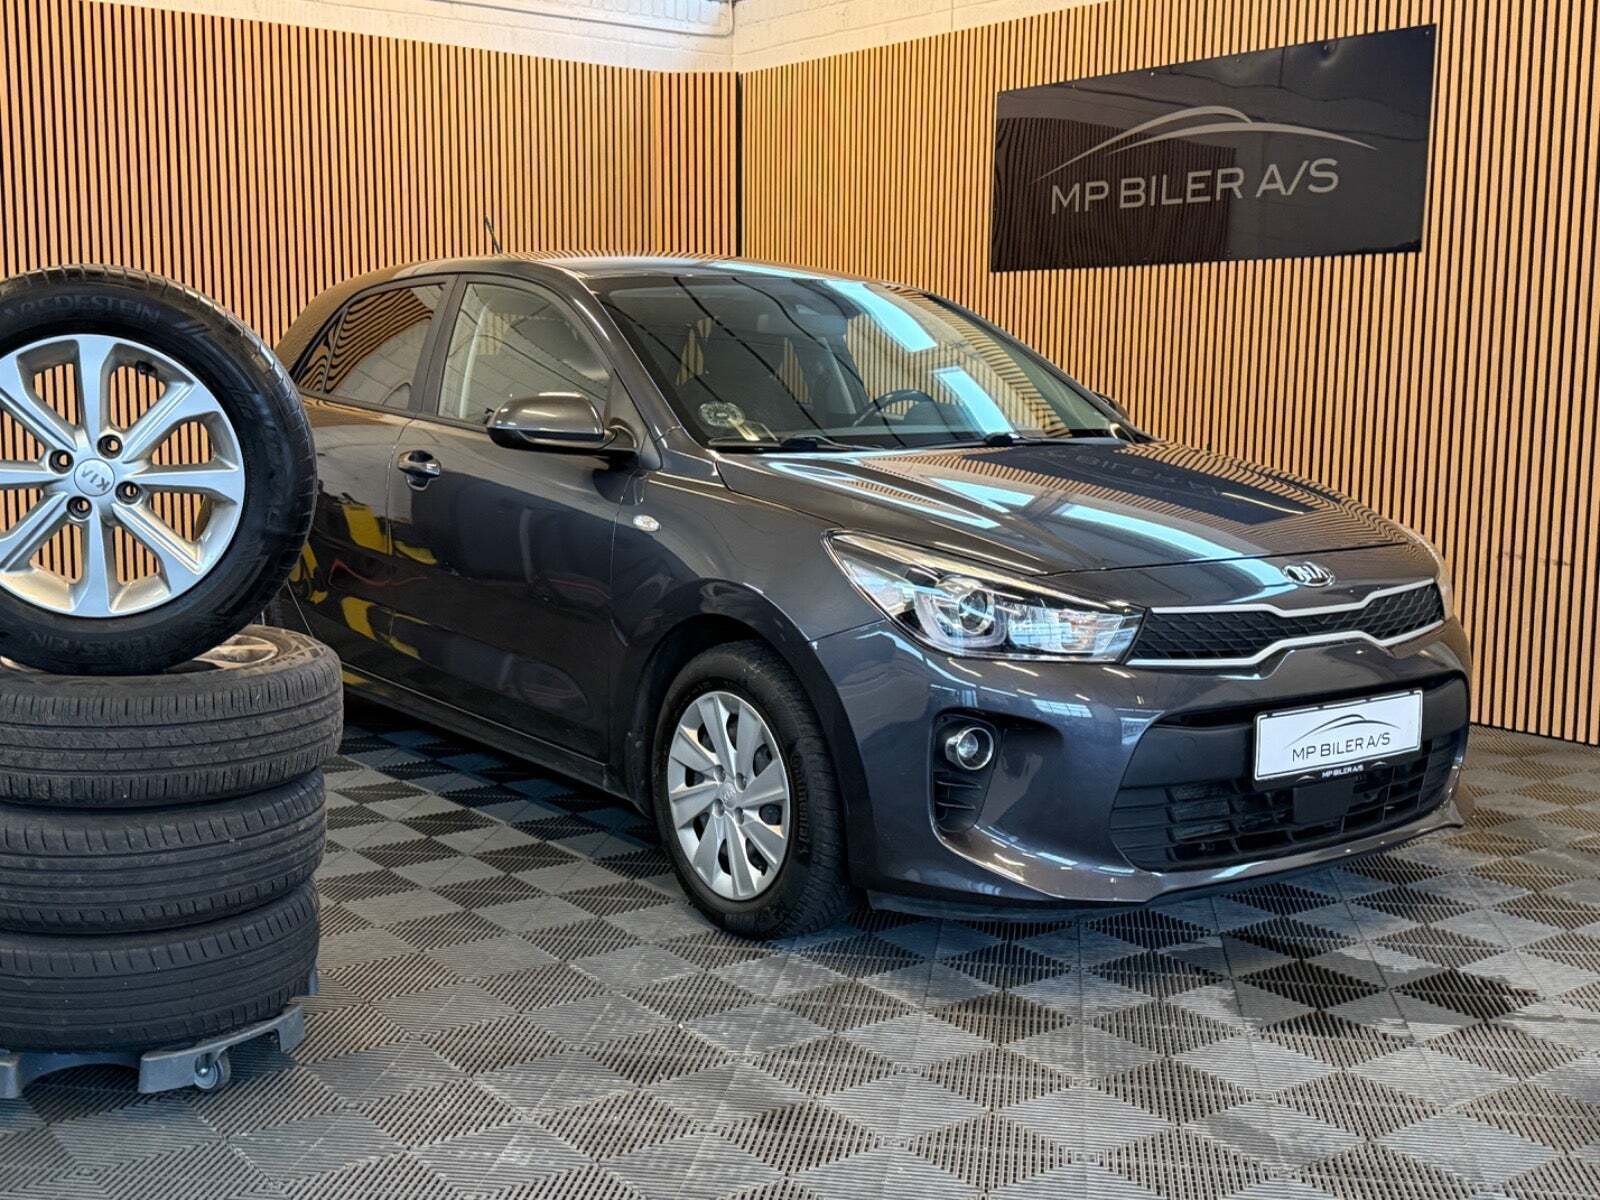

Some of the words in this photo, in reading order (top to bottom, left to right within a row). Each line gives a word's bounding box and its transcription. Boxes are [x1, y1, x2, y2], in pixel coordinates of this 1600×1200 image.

[1051, 181, 1109, 215] MP
[1119, 167, 1244, 210] BILER
[1256, 158, 1340, 199] A/S
[81, 465, 110, 491] KIA
[1292, 745, 1317, 763] MP
[1320, 737, 1363, 757] BILER
[1366, 732, 1390, 748] A/S
[1322, 770, 1332, 778] MP
[1333, 766, 1352, 776] BILER
